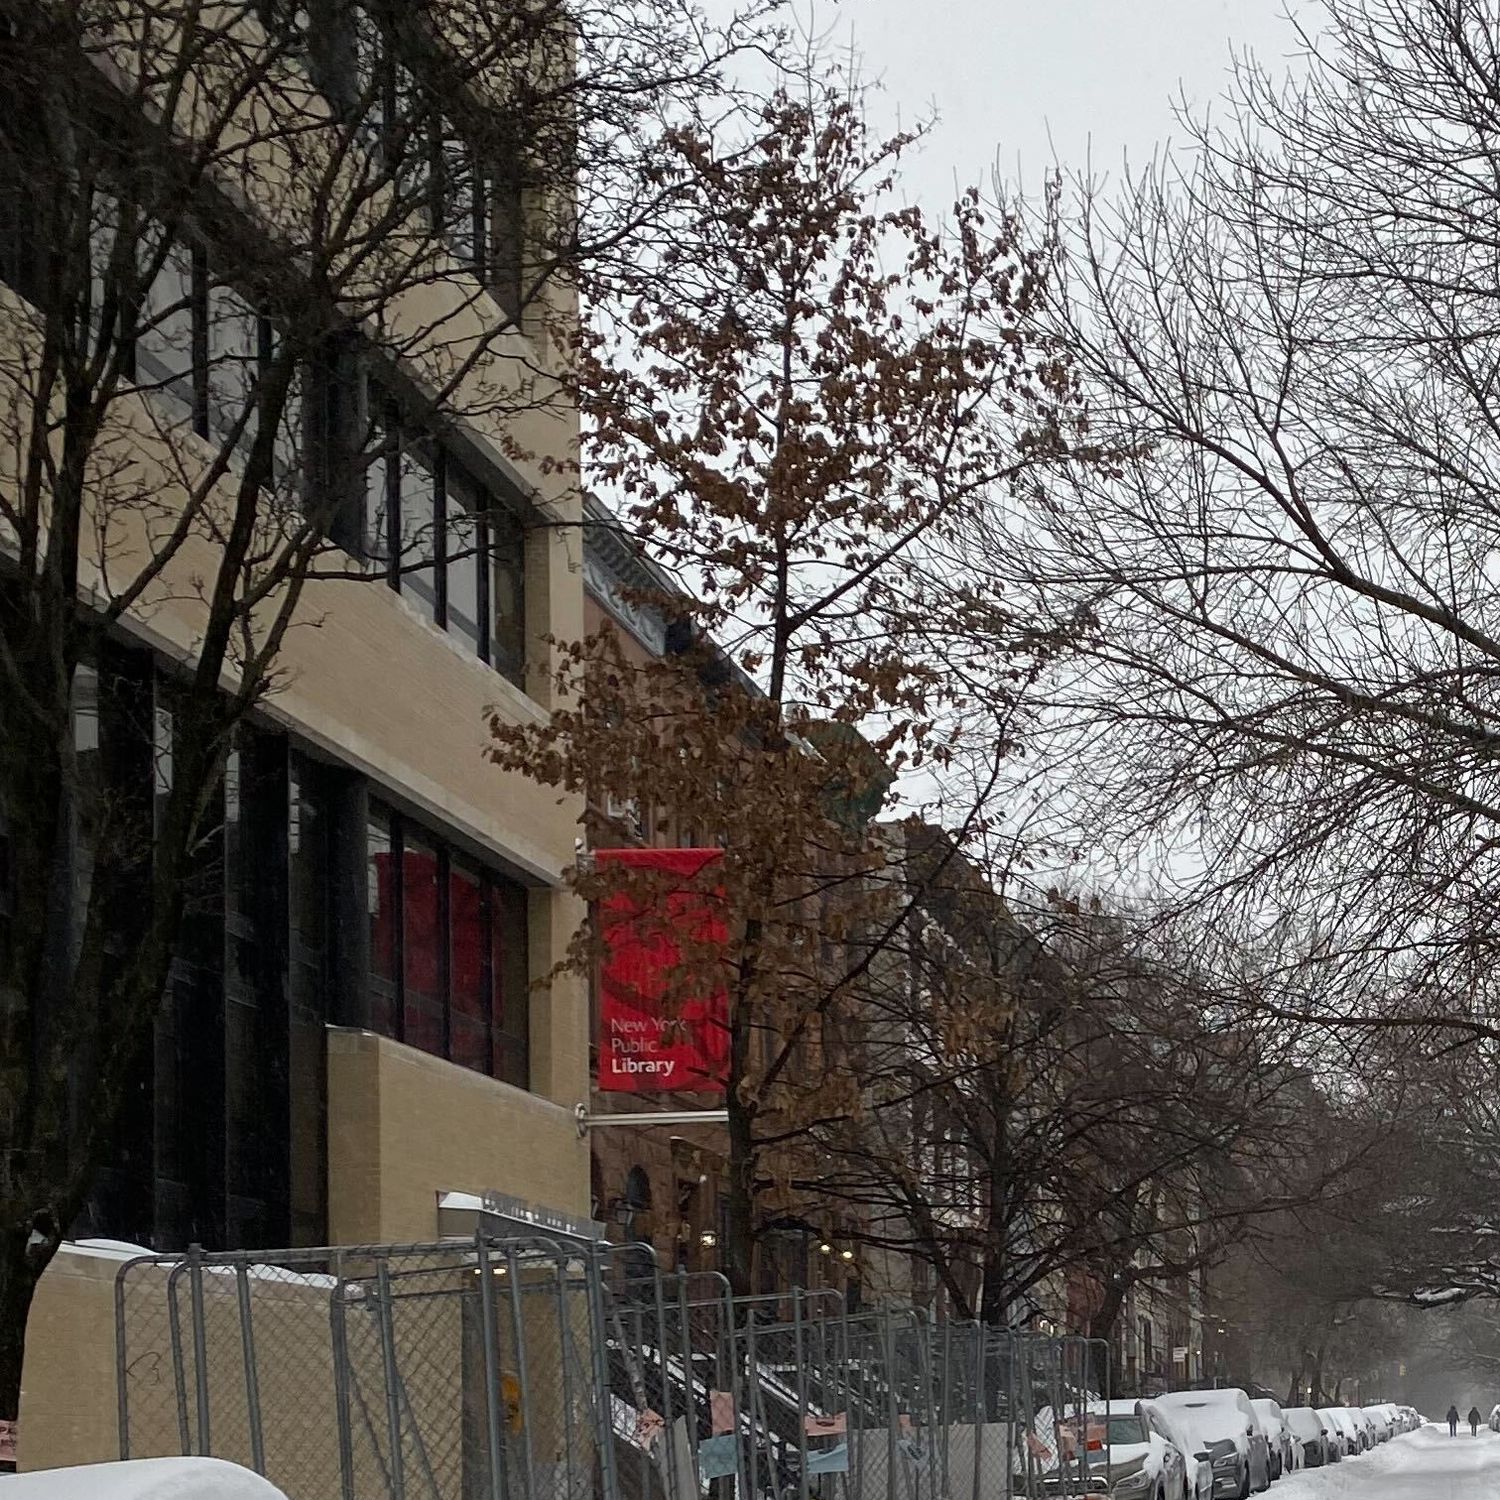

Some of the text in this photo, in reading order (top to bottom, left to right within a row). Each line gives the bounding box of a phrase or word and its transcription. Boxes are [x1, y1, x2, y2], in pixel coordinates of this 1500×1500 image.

[611, 1018, 647, 1033] New
[611, 1036, 658, 1053] Public
[611, 1057, 675, 1077] Library
